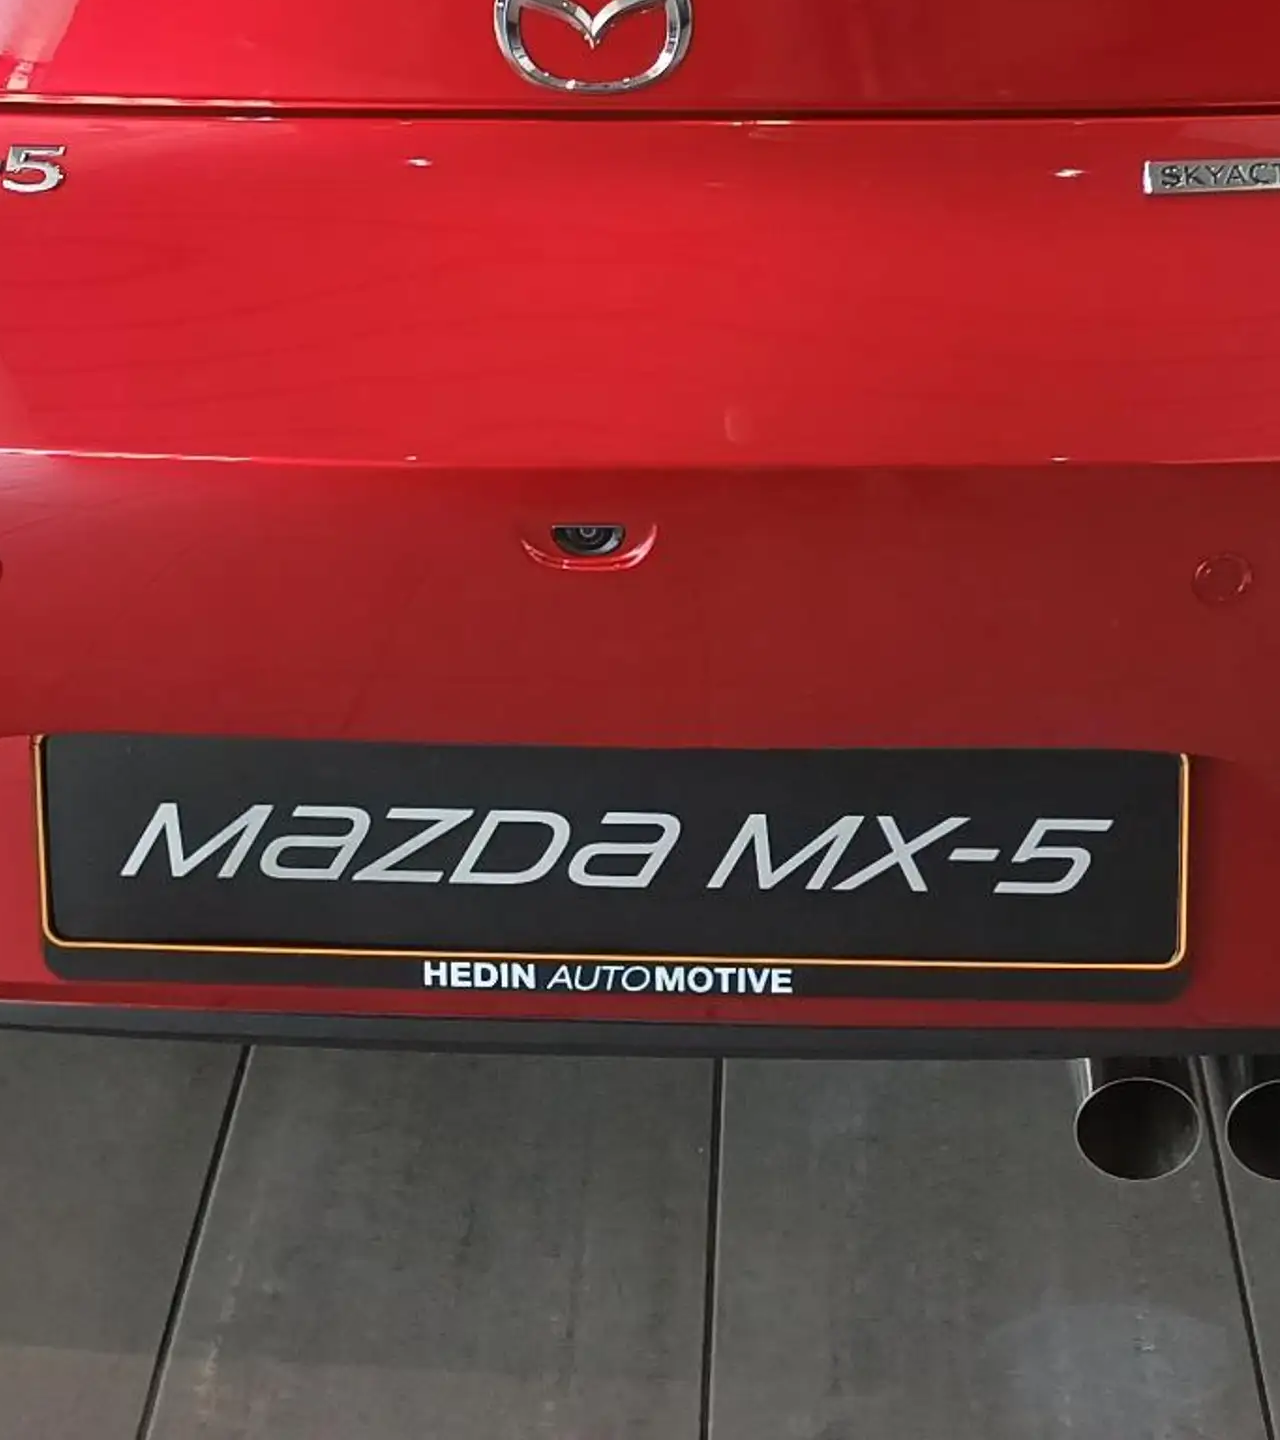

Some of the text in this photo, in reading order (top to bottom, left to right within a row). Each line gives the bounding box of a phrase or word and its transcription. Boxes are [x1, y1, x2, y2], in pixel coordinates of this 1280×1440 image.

[707, 812, 1115, 897] MX-5
[423, 961, 793, 994] HEDIN AUTOMOTIVE
